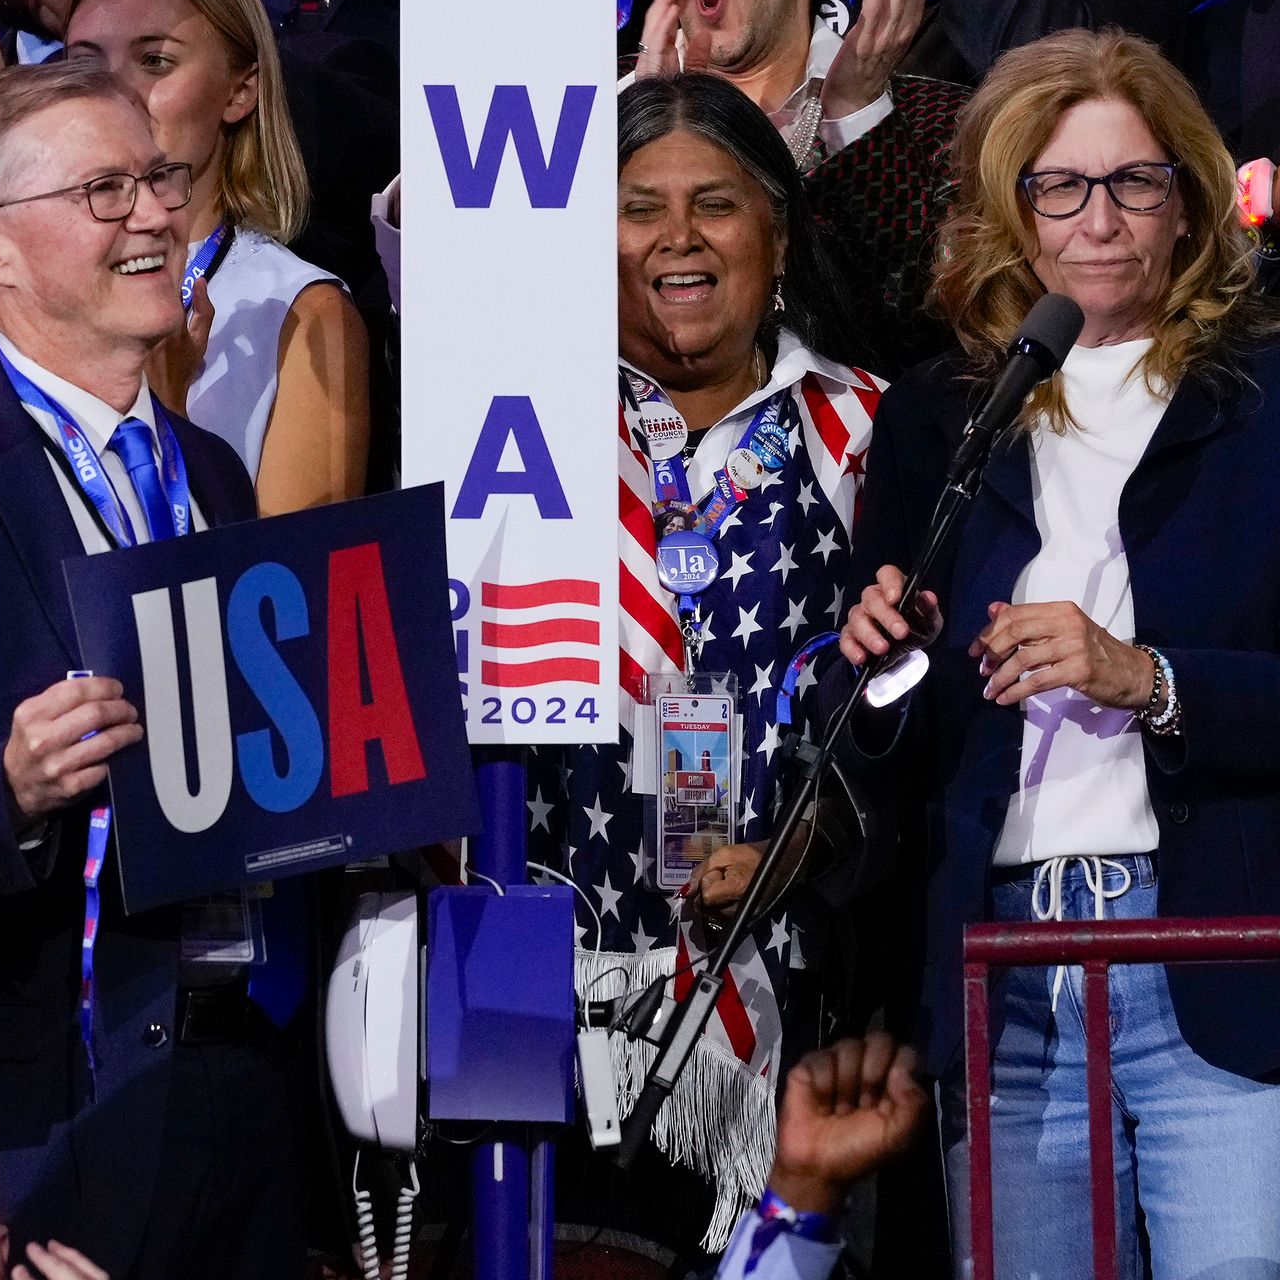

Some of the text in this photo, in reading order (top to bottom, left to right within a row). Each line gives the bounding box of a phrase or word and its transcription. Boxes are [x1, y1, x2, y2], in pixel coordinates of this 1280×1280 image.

[646, 421, 684, 433] ERANS
[68, 439, 97, 483] DNC
[655, 459, 673, 485] NC
[173, 504, 186, 536] DN
[131, 542, 427, 834] USA
[481, 697, 600, 724] 2024
[721, 703, 727, 719] 2
